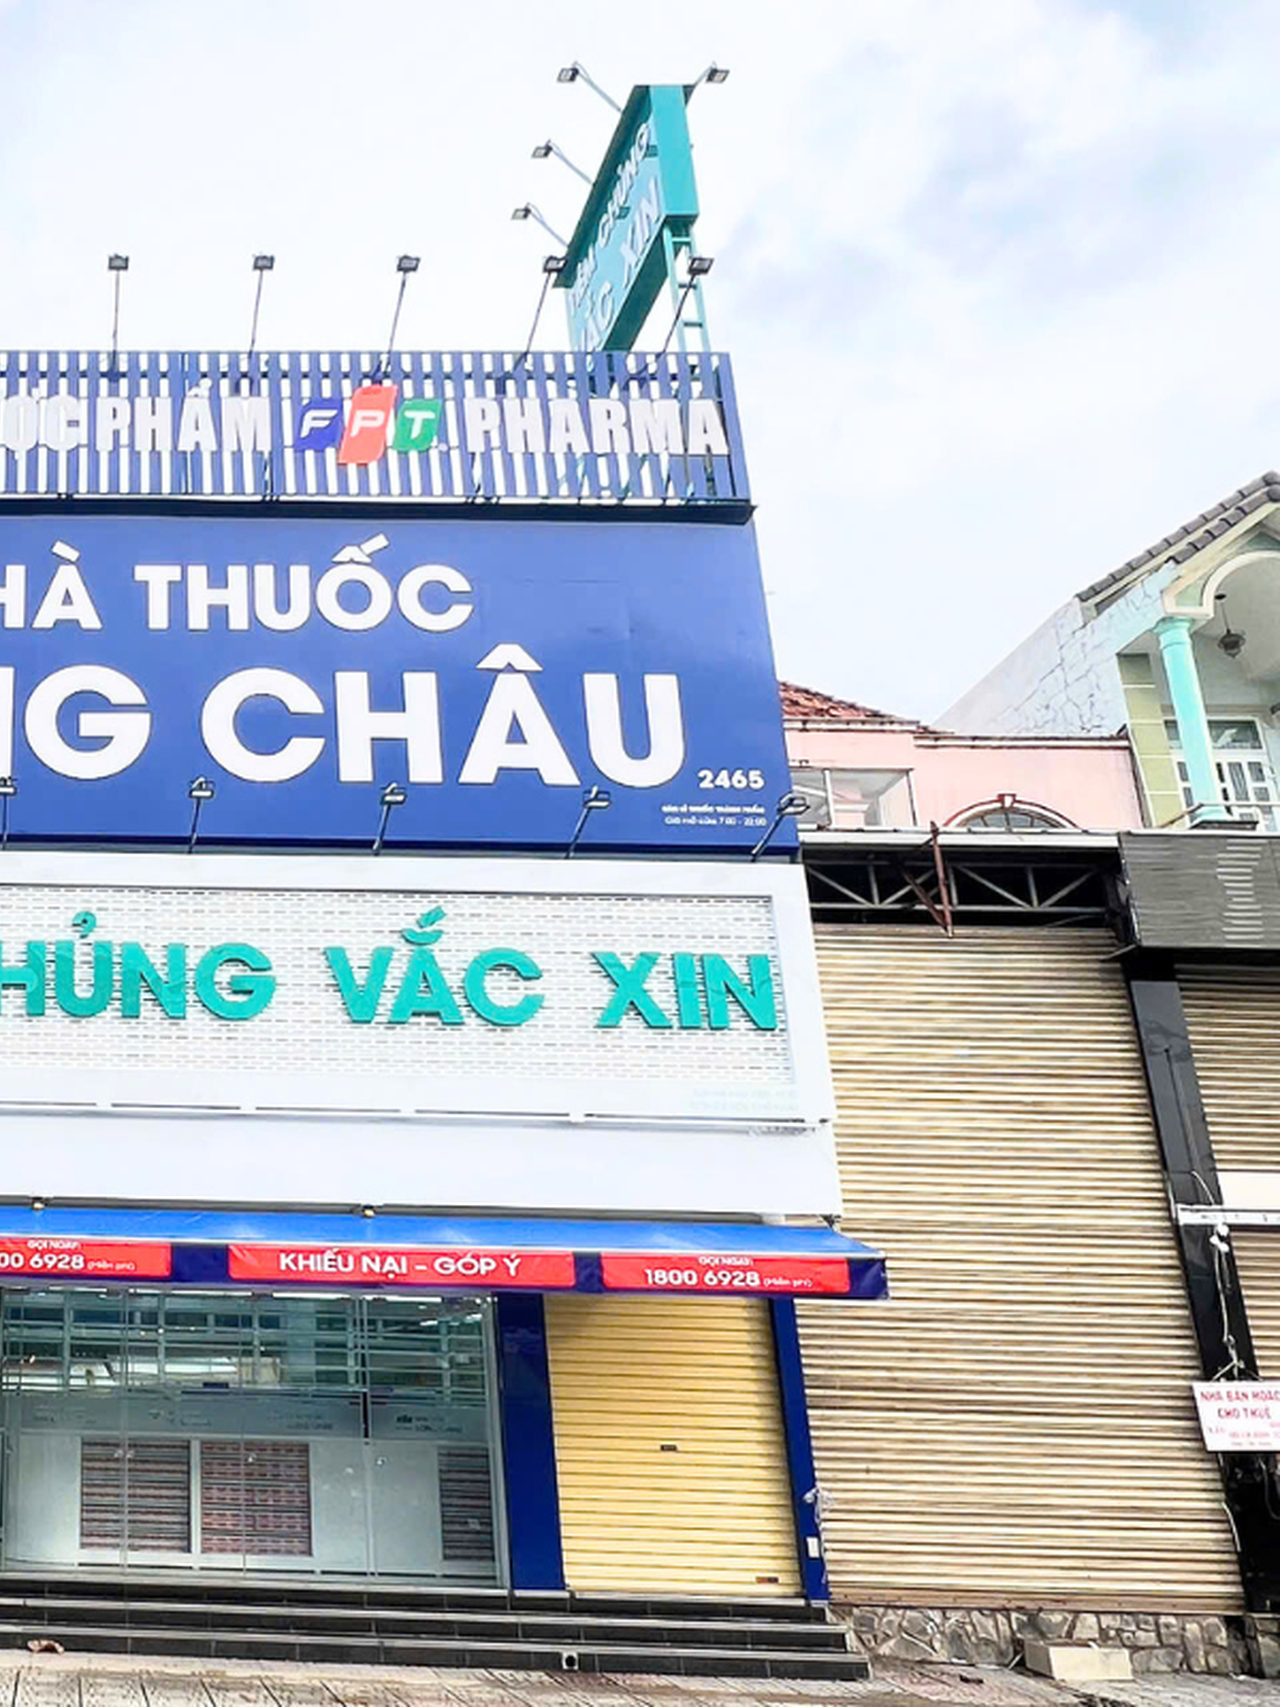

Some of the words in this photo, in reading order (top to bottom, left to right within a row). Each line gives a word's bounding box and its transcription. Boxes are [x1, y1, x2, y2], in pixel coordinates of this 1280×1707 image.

[95, 378, 272, 452] PHẨM
[464, 398, 729, 455] PHARMA
[133, 532, 474, 633] THUỐC
[200, 643, 687, 788] CHÂU
[698, 768, 765, 790] 2465
[322, 906, 546, 1027] VẮC
[590, 951, 779, 1031] XIN
[29, 1252, 85, 1270] 6928
[279, 1247, 355, 1274] KHIẾU
[361, 1253, 408, 1280] NẠI
[433, 1252, 497, 1276] GÓP
[502, 1253, 522, 1277] Ý
[644, 1268, 698, 1286] 1800
[703, 1269, 761, 1287] 6928
